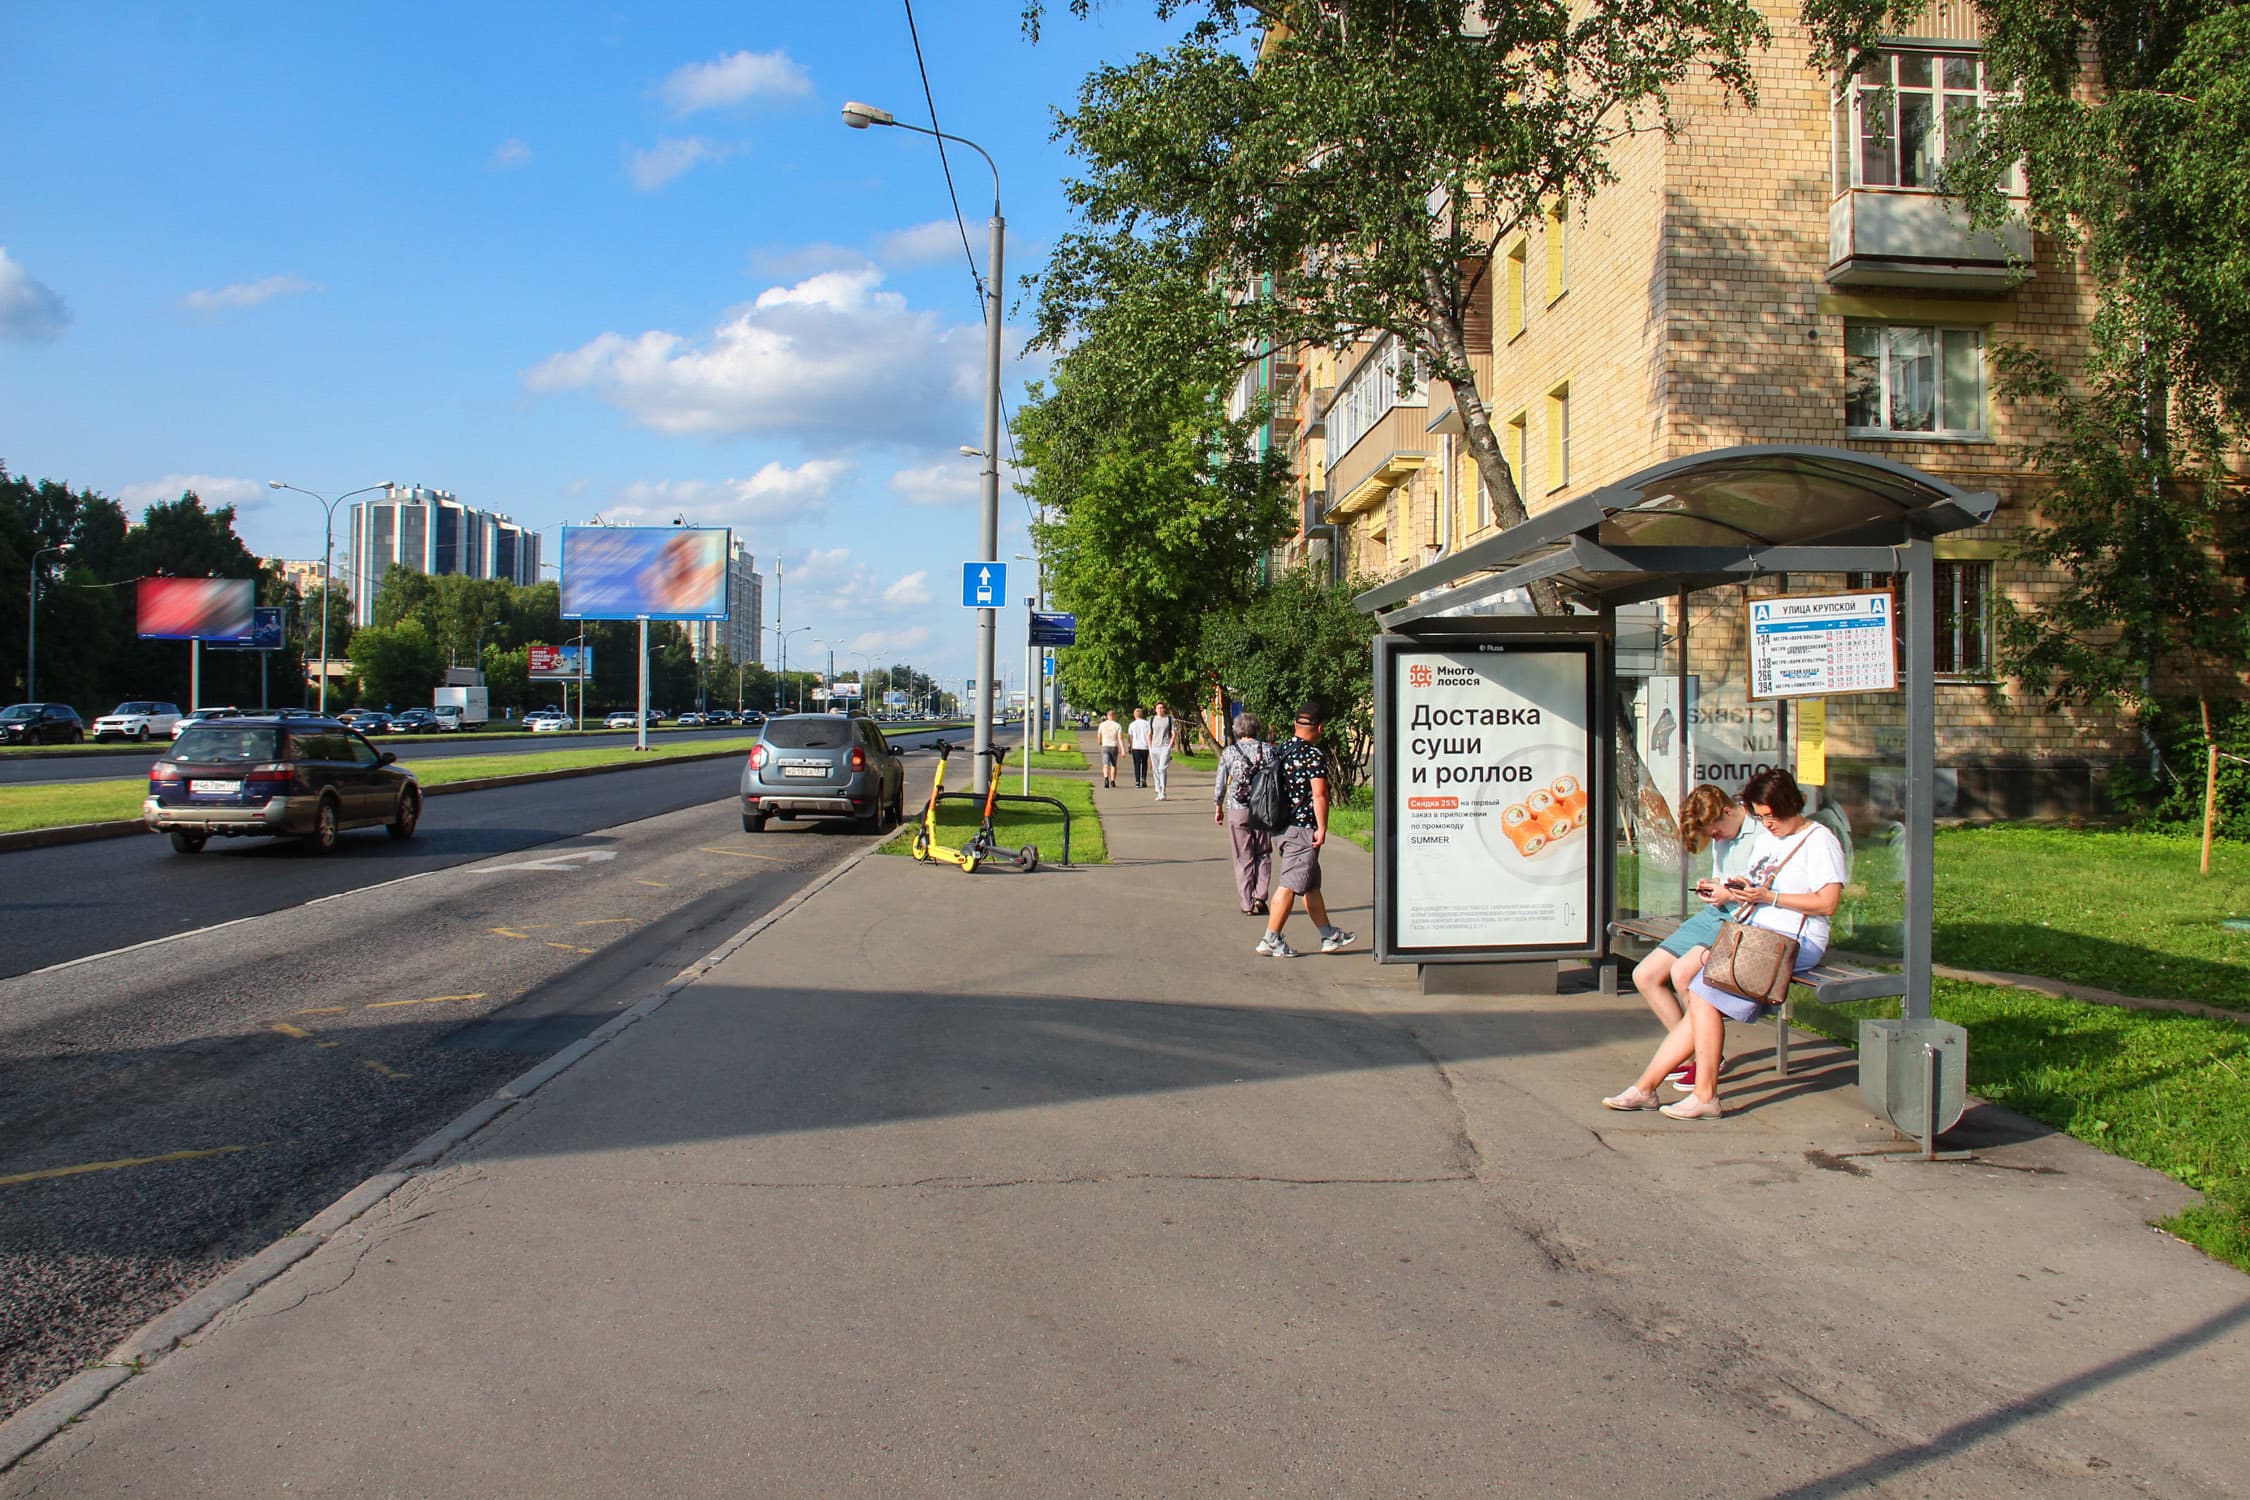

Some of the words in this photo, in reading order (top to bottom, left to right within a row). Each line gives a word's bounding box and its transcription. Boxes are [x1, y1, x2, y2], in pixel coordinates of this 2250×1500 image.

[1782, 603, 1811, 615] УЛИЦА
[1813, 600, 1856, 612] КРУПСКОЙ
[1762, 646, 1766, 657] 1
[1758, 657, 1771, 669] 138
[1437, 666, 1474, 676] Много
[1758, 670, 1772, 681] 266
[1437, 678, 1480, 686] лосося
[1758, 682, 1773, 693] 394
[1411, 704, 1541, 731] Доставка
[1412, 737, 1481, 760] суши
[1412, 767, 1427, 783] и
[1436, 765, 1533, 789] роллов
[1410, 799, 1440, 808] Скидка
[1441, 799, 1457, 807] 25%
[1471, 799, 1500, 807] первый
[1440, 811, 1487, 819] приложении
[1422, 823, 1464, 831] промокоду
[1411, 835, 1450, 844] SUMMER
